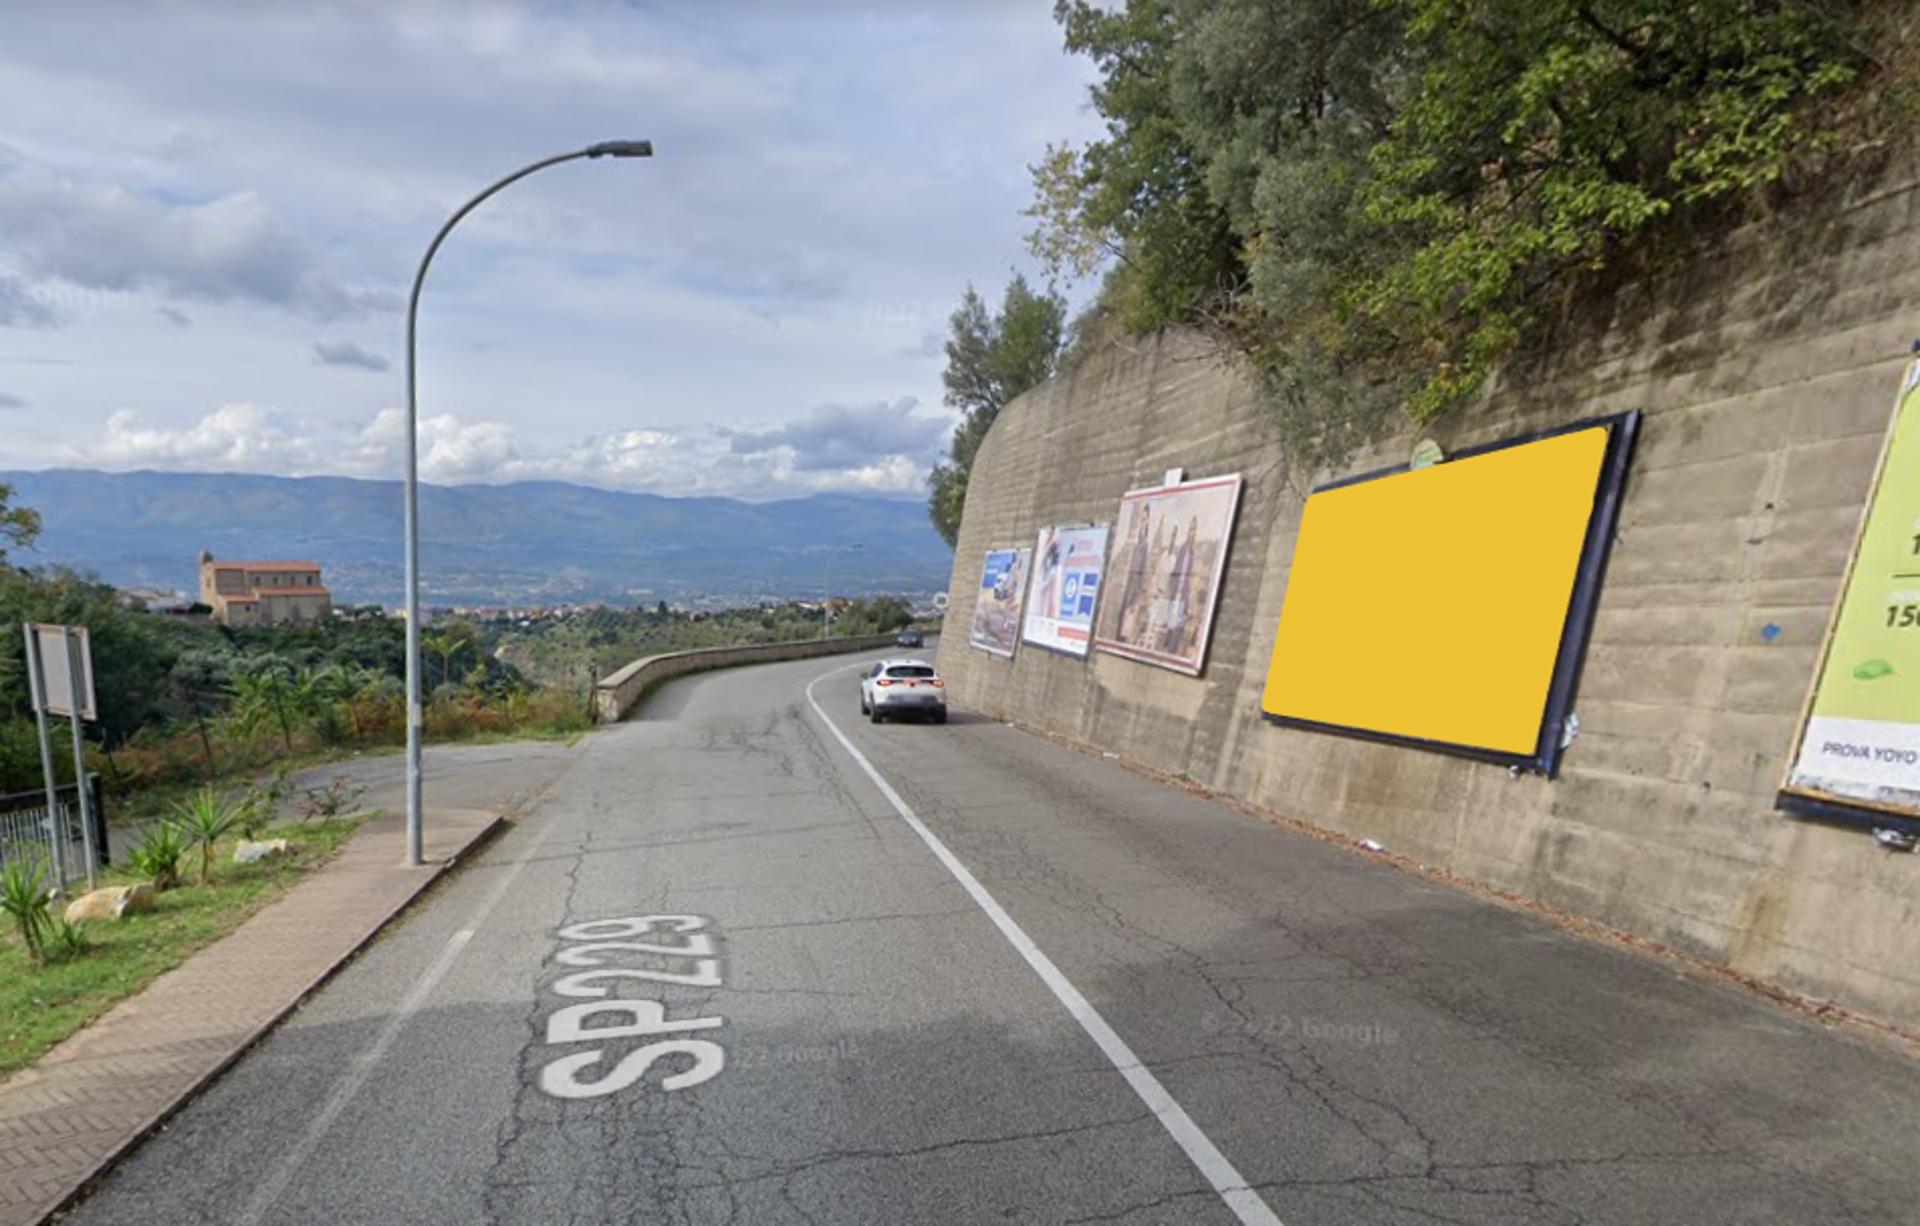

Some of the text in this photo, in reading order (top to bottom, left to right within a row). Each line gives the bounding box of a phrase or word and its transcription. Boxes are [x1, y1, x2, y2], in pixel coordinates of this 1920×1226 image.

[1823, 742, 1918, 764] PROVA YOYO
[541, 914, 725, 1099] SP229
